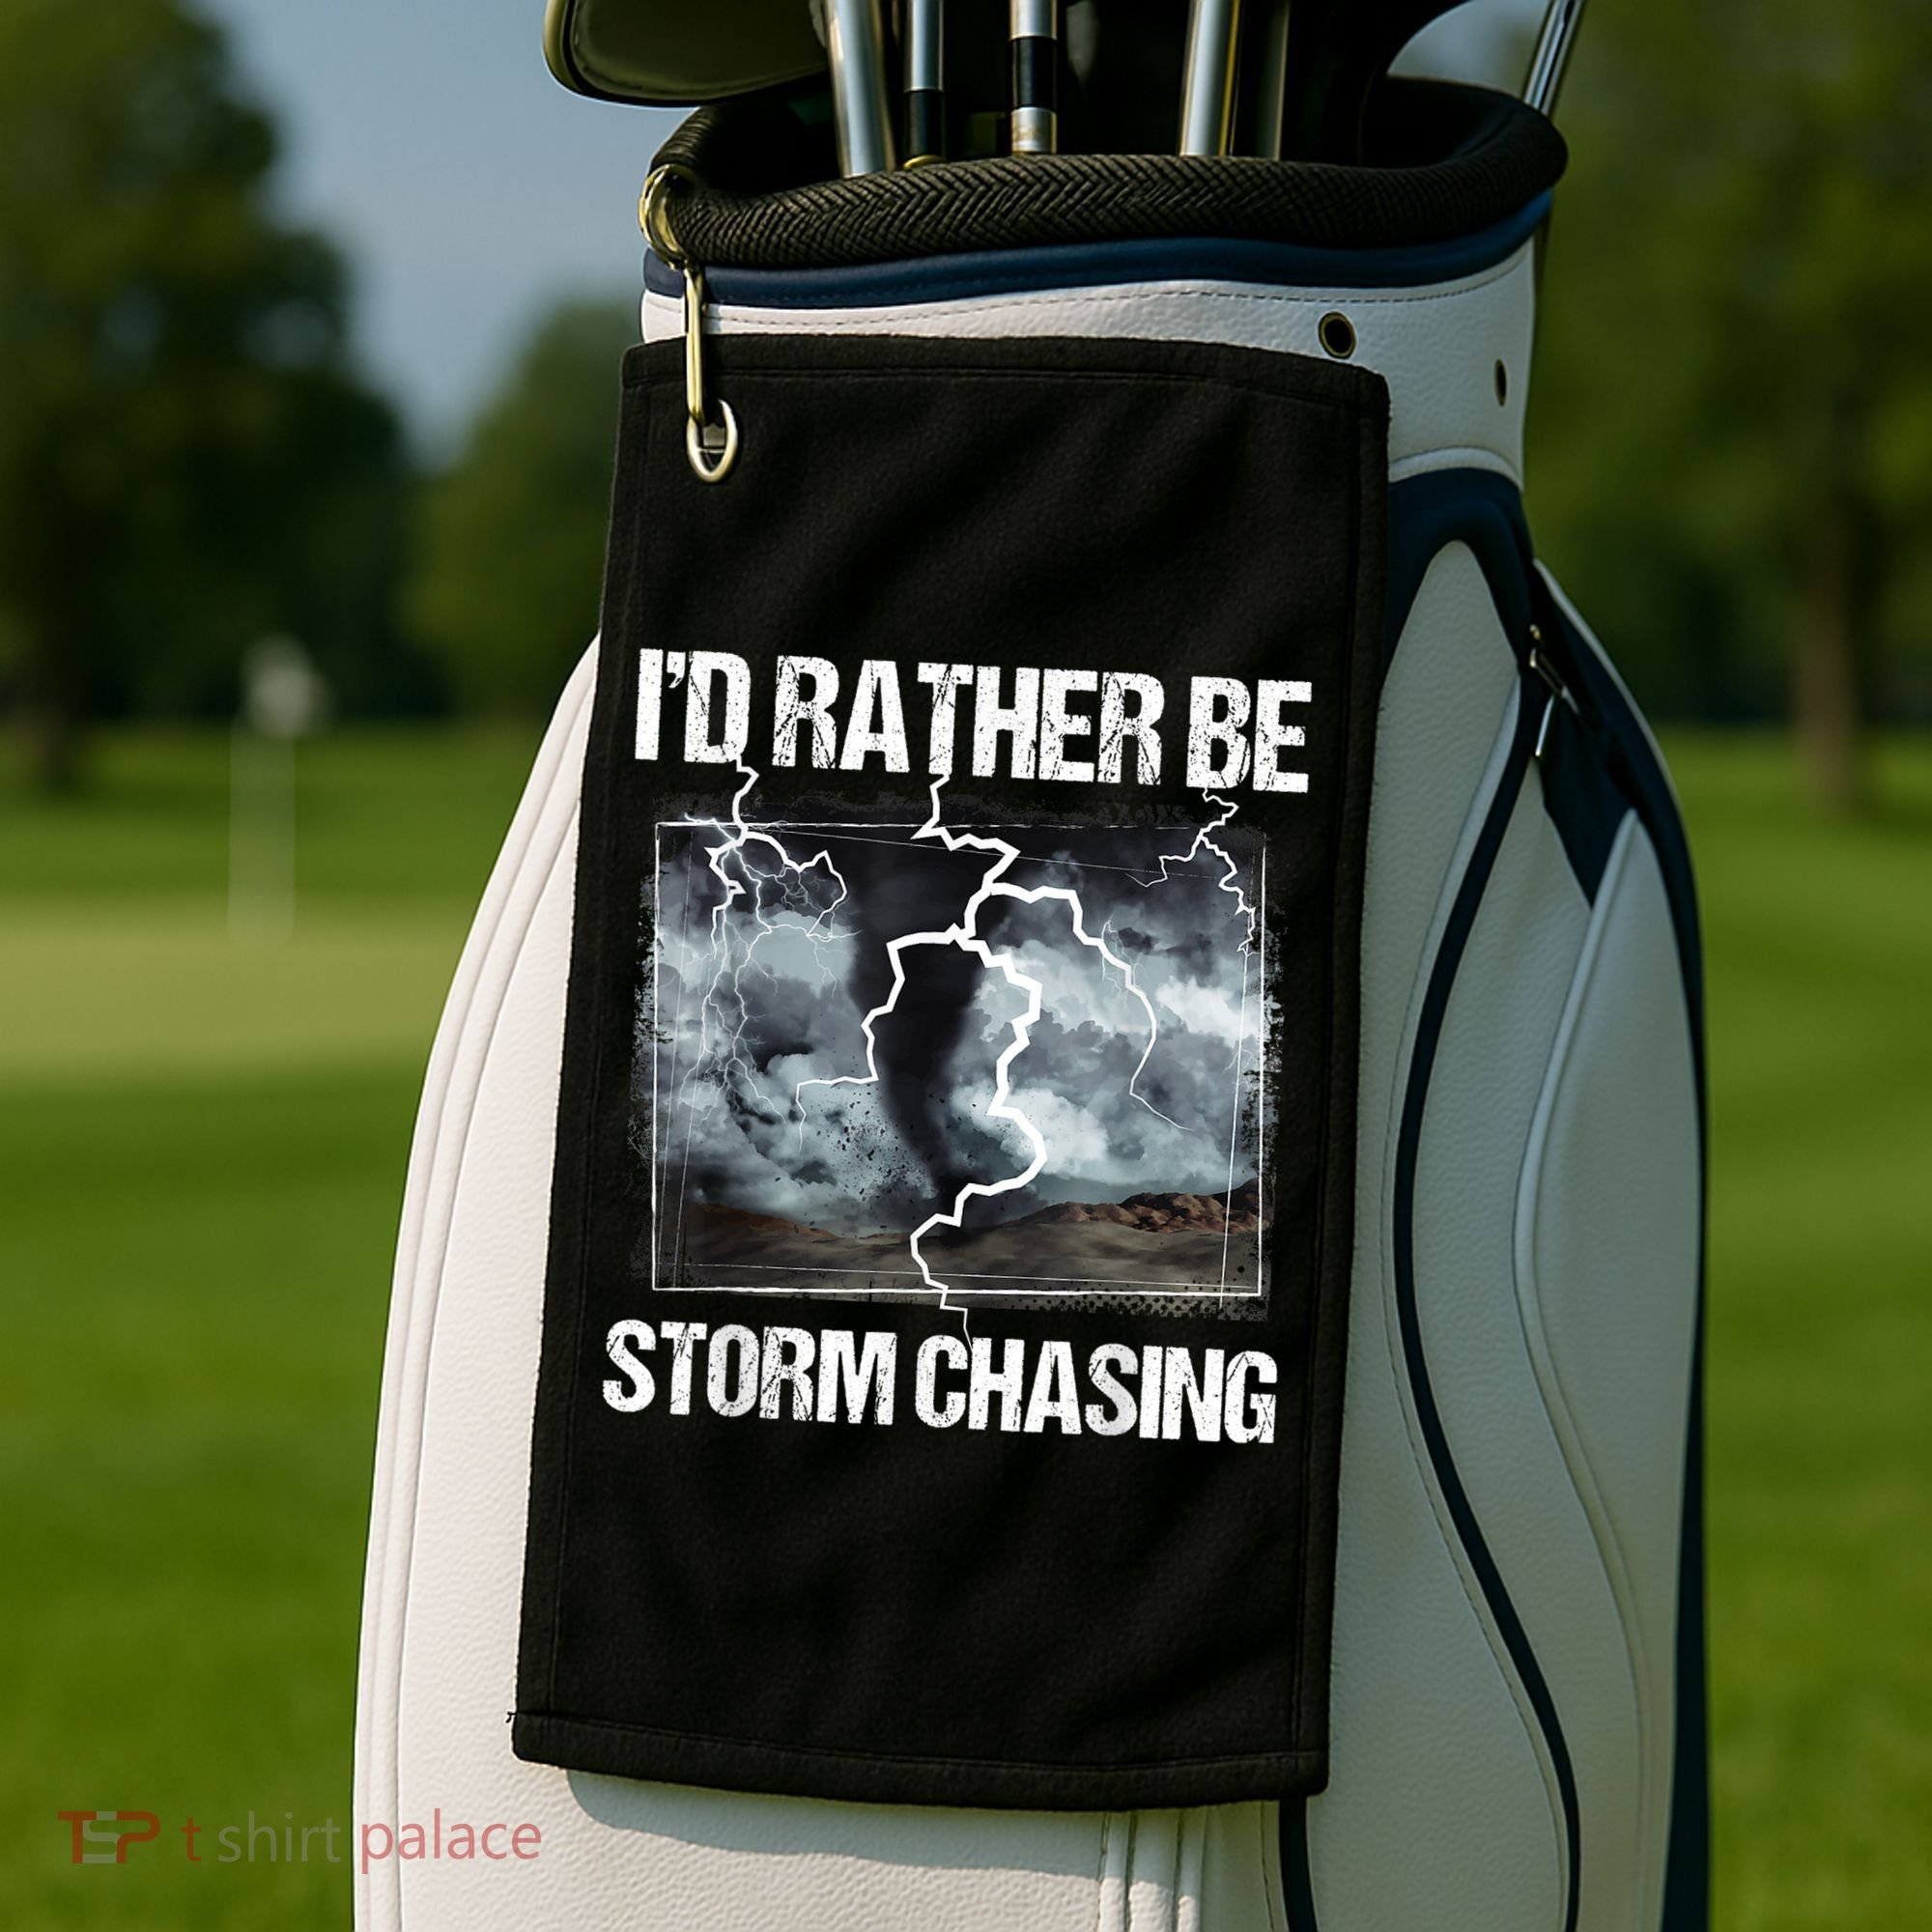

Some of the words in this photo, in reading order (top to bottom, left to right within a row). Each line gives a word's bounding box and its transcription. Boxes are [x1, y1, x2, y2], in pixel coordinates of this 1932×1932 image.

[635, 648, 752, 763] I'D
[772, 655, 1165, 785] RATHER
[1186, 676, 1313, 793] BE
[603, 1320, 896, 1426] STORM
[915, 1335, 1277, 1443] CHASING
